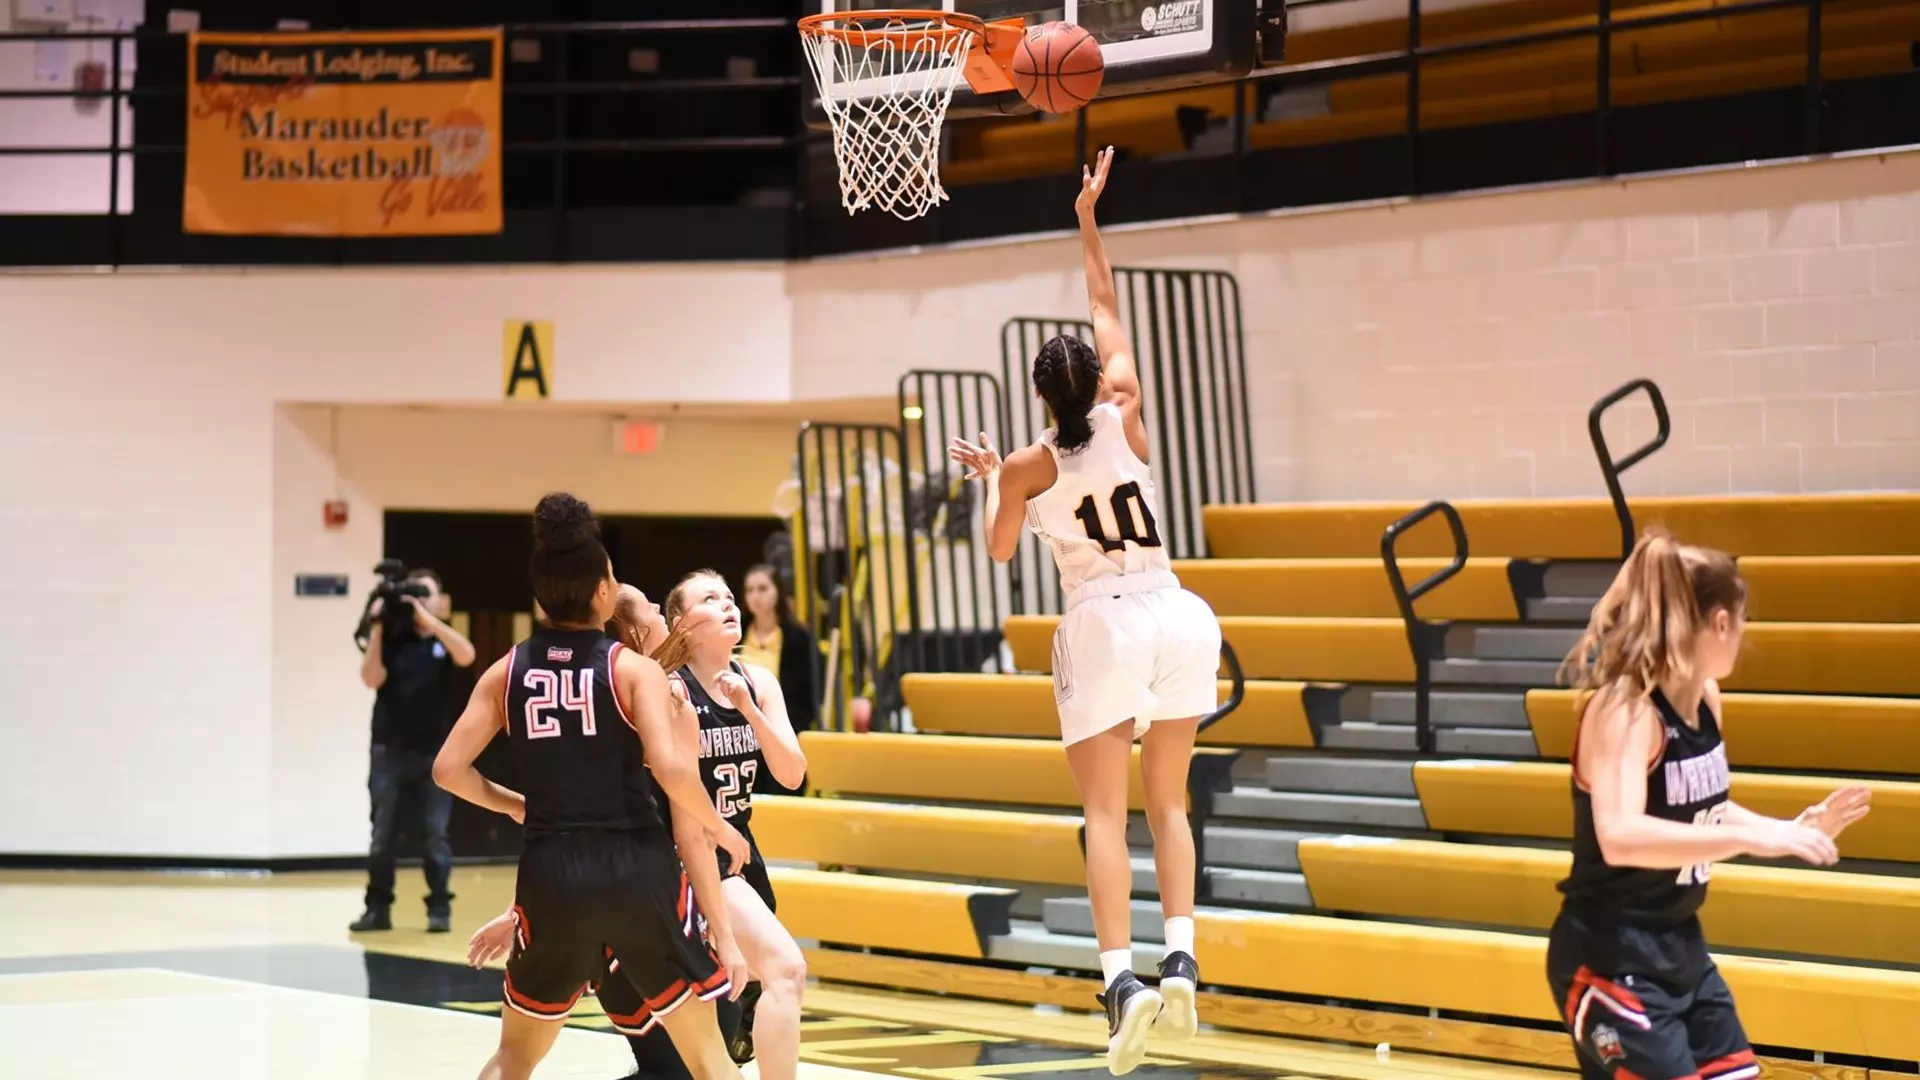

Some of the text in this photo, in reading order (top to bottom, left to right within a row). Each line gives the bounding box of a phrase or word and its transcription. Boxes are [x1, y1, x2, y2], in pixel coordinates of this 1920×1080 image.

[1157, 1, 1200, 20] SCHUTT
[212, 49, 308, 75] Student
[426, 48, 475, 73] Inc.
[240, 108, 430, 141] Marauder
[240, 148, 434, 181] Basketball
[379, 172, 413, 227] Go
[506, 321, 547, 396] A
[1074, 481, 1161, 552] 10
[523, 668, 597, 739] 24
[713, 759, 758, 818] 23
